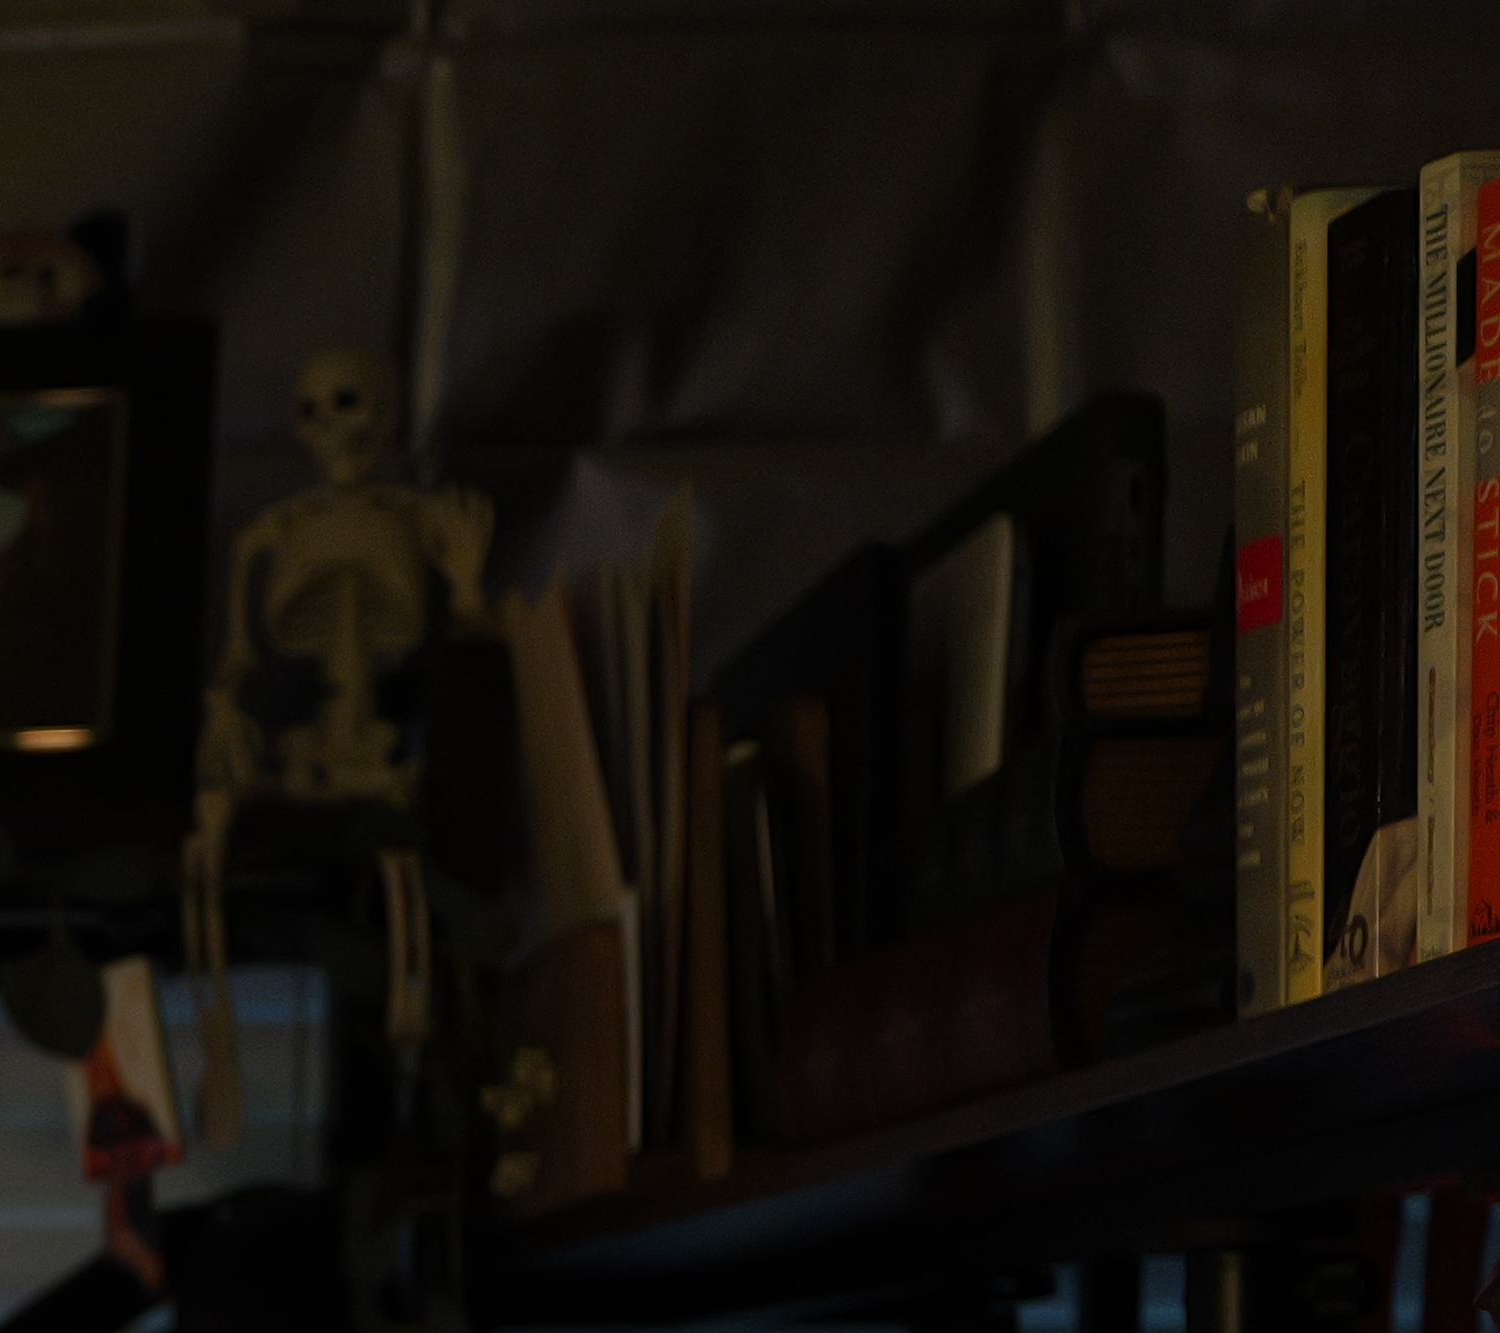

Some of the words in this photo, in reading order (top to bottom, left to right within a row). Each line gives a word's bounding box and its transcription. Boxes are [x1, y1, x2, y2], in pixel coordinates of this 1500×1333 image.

[1426, 203, 1448, 266] THE
[1479, 224, 1500, 383] MADE
[1425, 272, 1447, 461] MILLIONAIRE
[1425, 467, 1446, 542] NEXT
[1475, 477, 1500, 641] STICK
[1424, 552, 1445, 633] DOOR
